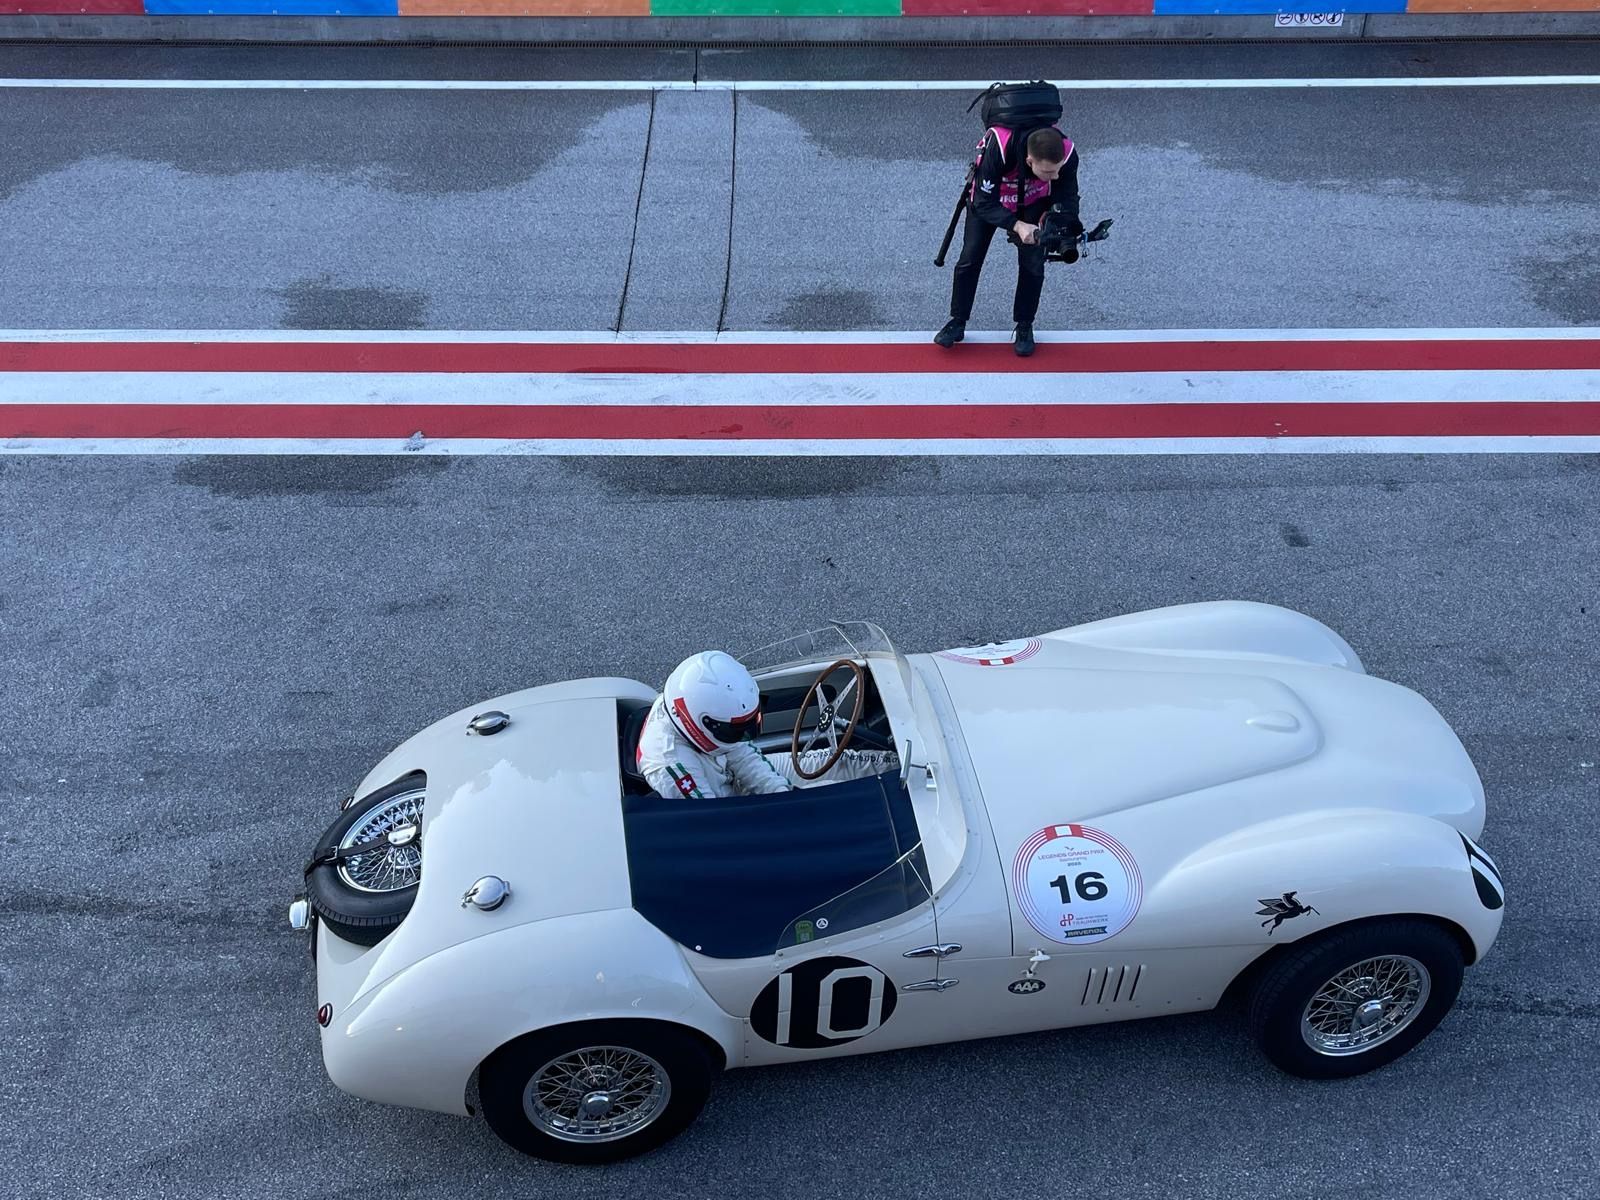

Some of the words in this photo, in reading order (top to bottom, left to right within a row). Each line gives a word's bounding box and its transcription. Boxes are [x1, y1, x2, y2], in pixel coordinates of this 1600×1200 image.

[1049, 871, 1108, 904] 16
[1067, 927, 1104, 937] RAVENOL
[1014, 981, 1039, 992] AAA
[776, 965, 885, 1044] 10
